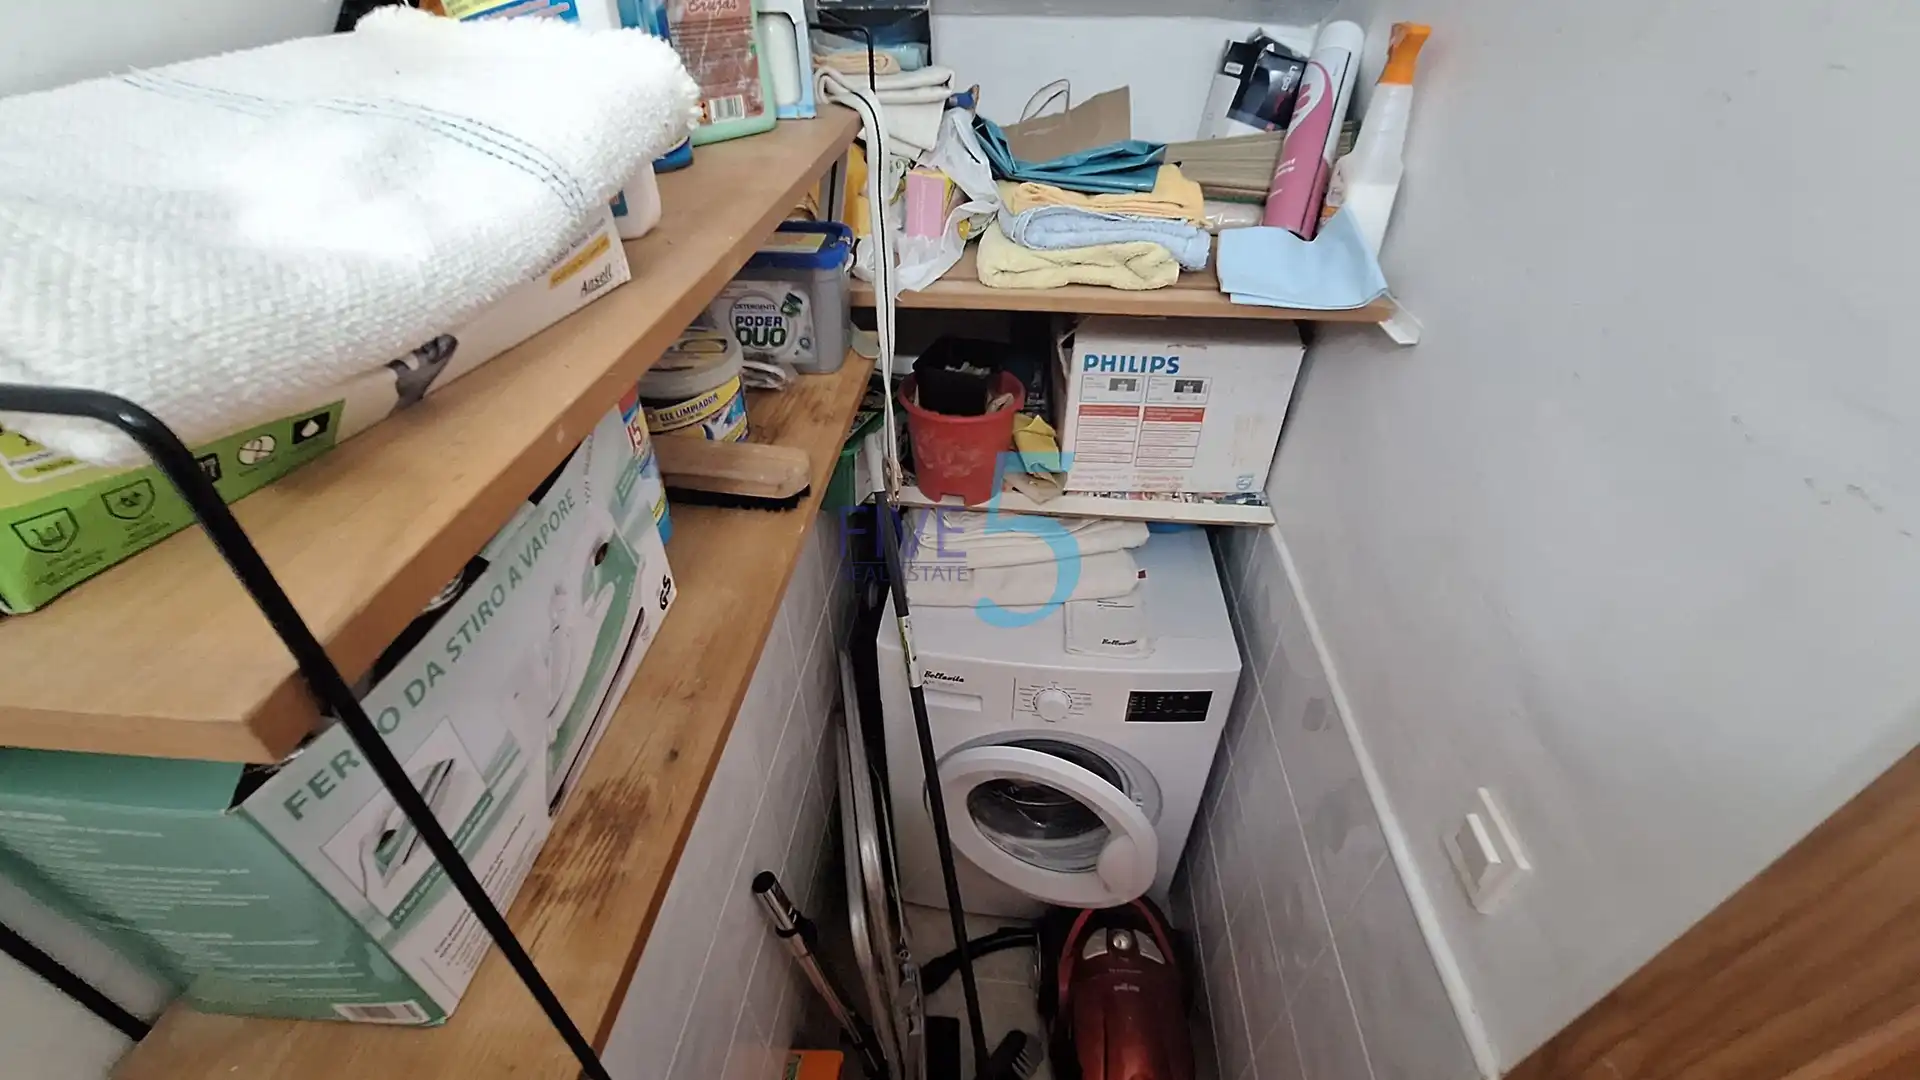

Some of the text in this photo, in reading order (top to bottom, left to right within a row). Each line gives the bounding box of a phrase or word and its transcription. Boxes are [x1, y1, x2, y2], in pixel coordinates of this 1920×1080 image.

[581, 263, 612, 295] Ansell
[734, 303, 776, 311] DETERGENTE
[735, 316, 783, 327] PODER
[736, 327, 787, 347] DUO
[1083, 354, 1180, 374] PHILIPS
[675, 392, 719, 418] LIMPIADOR
[283, 487, 576, 821] FERO DA STIRO A VAPORE
